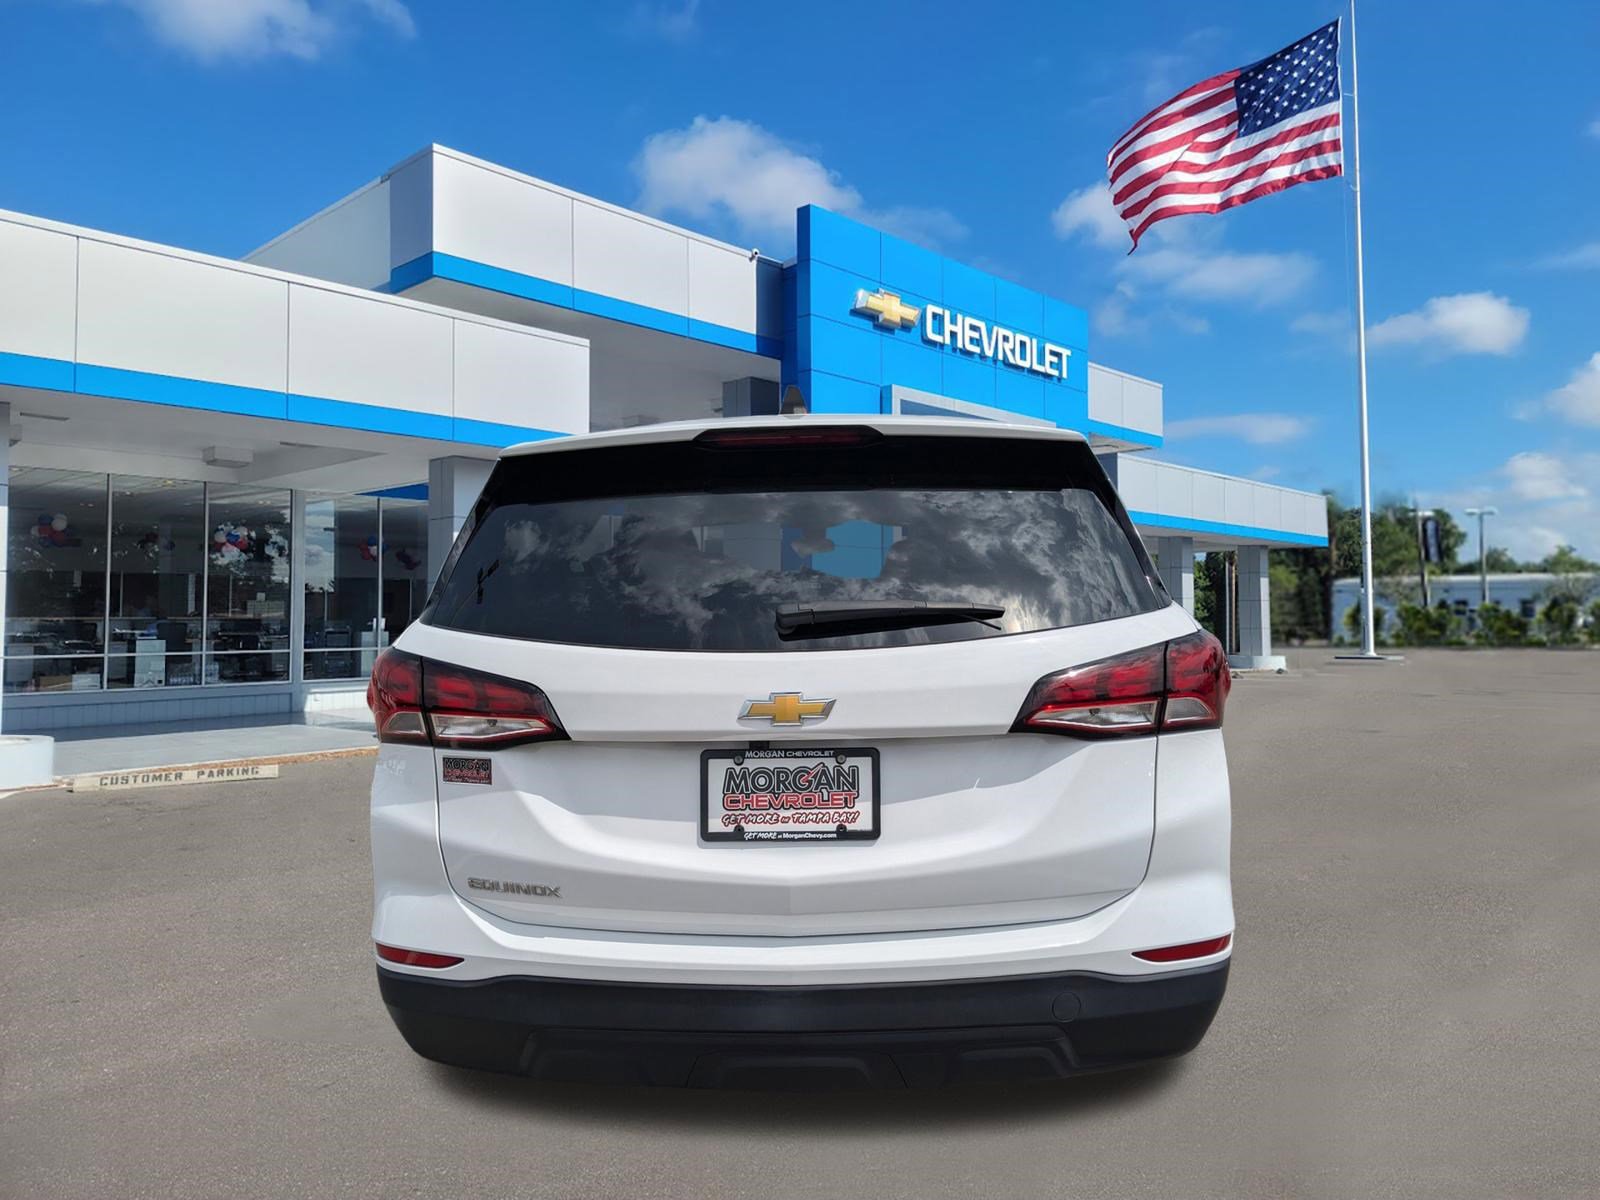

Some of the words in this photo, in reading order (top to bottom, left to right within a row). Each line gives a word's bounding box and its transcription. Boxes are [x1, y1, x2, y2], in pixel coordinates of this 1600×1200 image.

[925, 304, 1071, 379] CHEVROLET
[745, 750, 785, 758] MORGAN
[100, 772, 183, 786] CUSTOMER
[197, 766, 259, 779] PARKING
[724, 763, 860, 794] MORGAN
[724, 792, 858, 810] CHEVROLET
[722, 813, 745, 827] GET
[746, 812, 780, 825] MORE
[792, 812, 831, 824] TAMPA
[832, 811, 860, 823] BAY!
[744, 832, 756, 840] GET
[757, 832, 778, 840] MORE
[467, 877, 561, 898] EQUINOX
